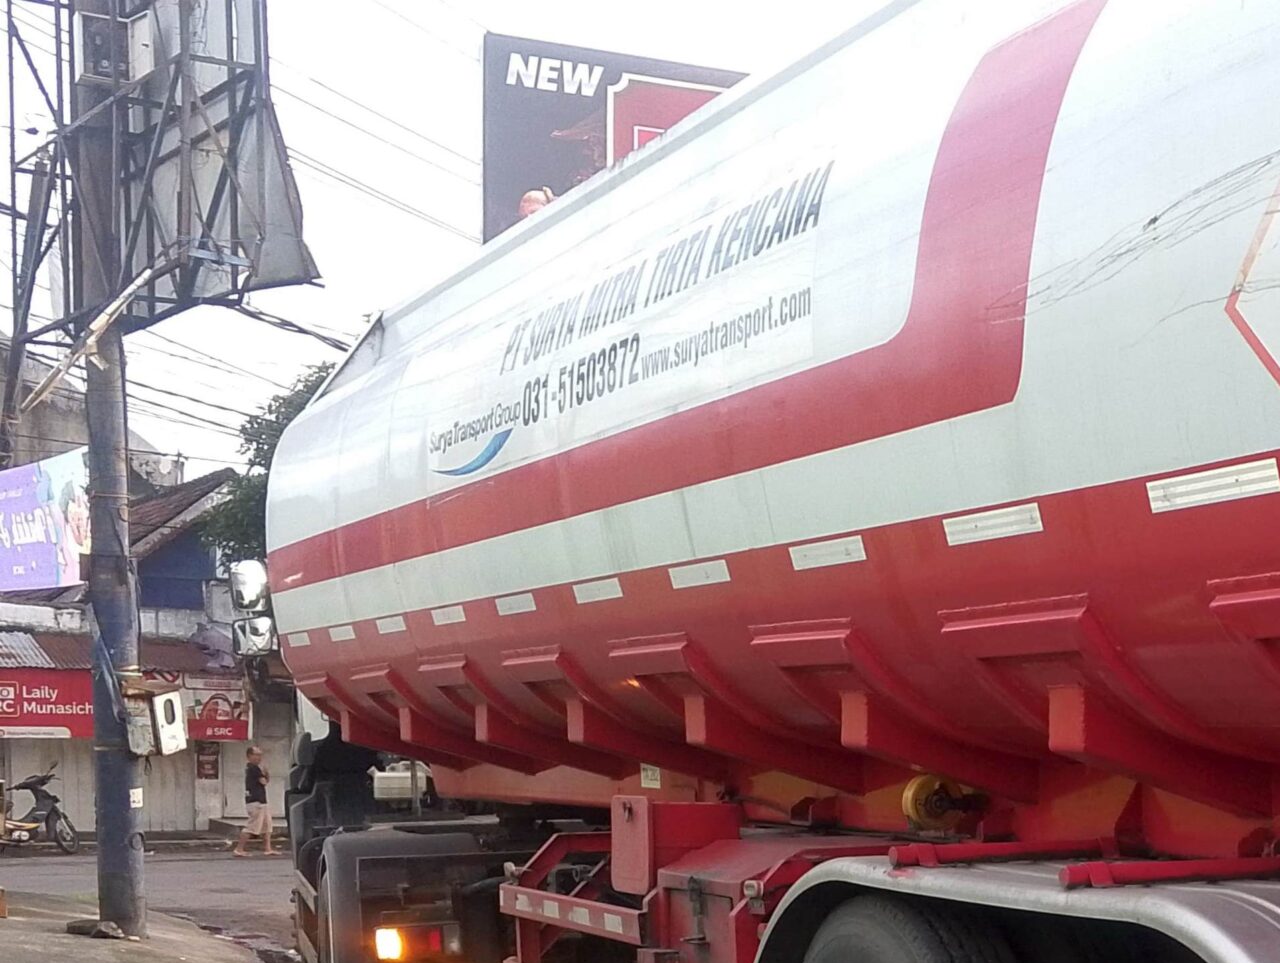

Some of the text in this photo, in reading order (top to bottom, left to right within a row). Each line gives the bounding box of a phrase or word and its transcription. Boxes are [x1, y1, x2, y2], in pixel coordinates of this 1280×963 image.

[506, 52, 604, 97] NEW
[523, 290, 584, 366] SURYA
[578, 258, 648, 339] MITRA
[645, 224, 713, 308] TIRTA
[705, 159, 836, 280] KENCANA
[641, 286, 812, 380] www.suryatransport.com
[522, 332, 641, 427] 031-51503872
[429, 400, 522, 454] Surya Transport Group
[22, 685, 58, 702] Laily
[214, 727, 233, 736] SRC
